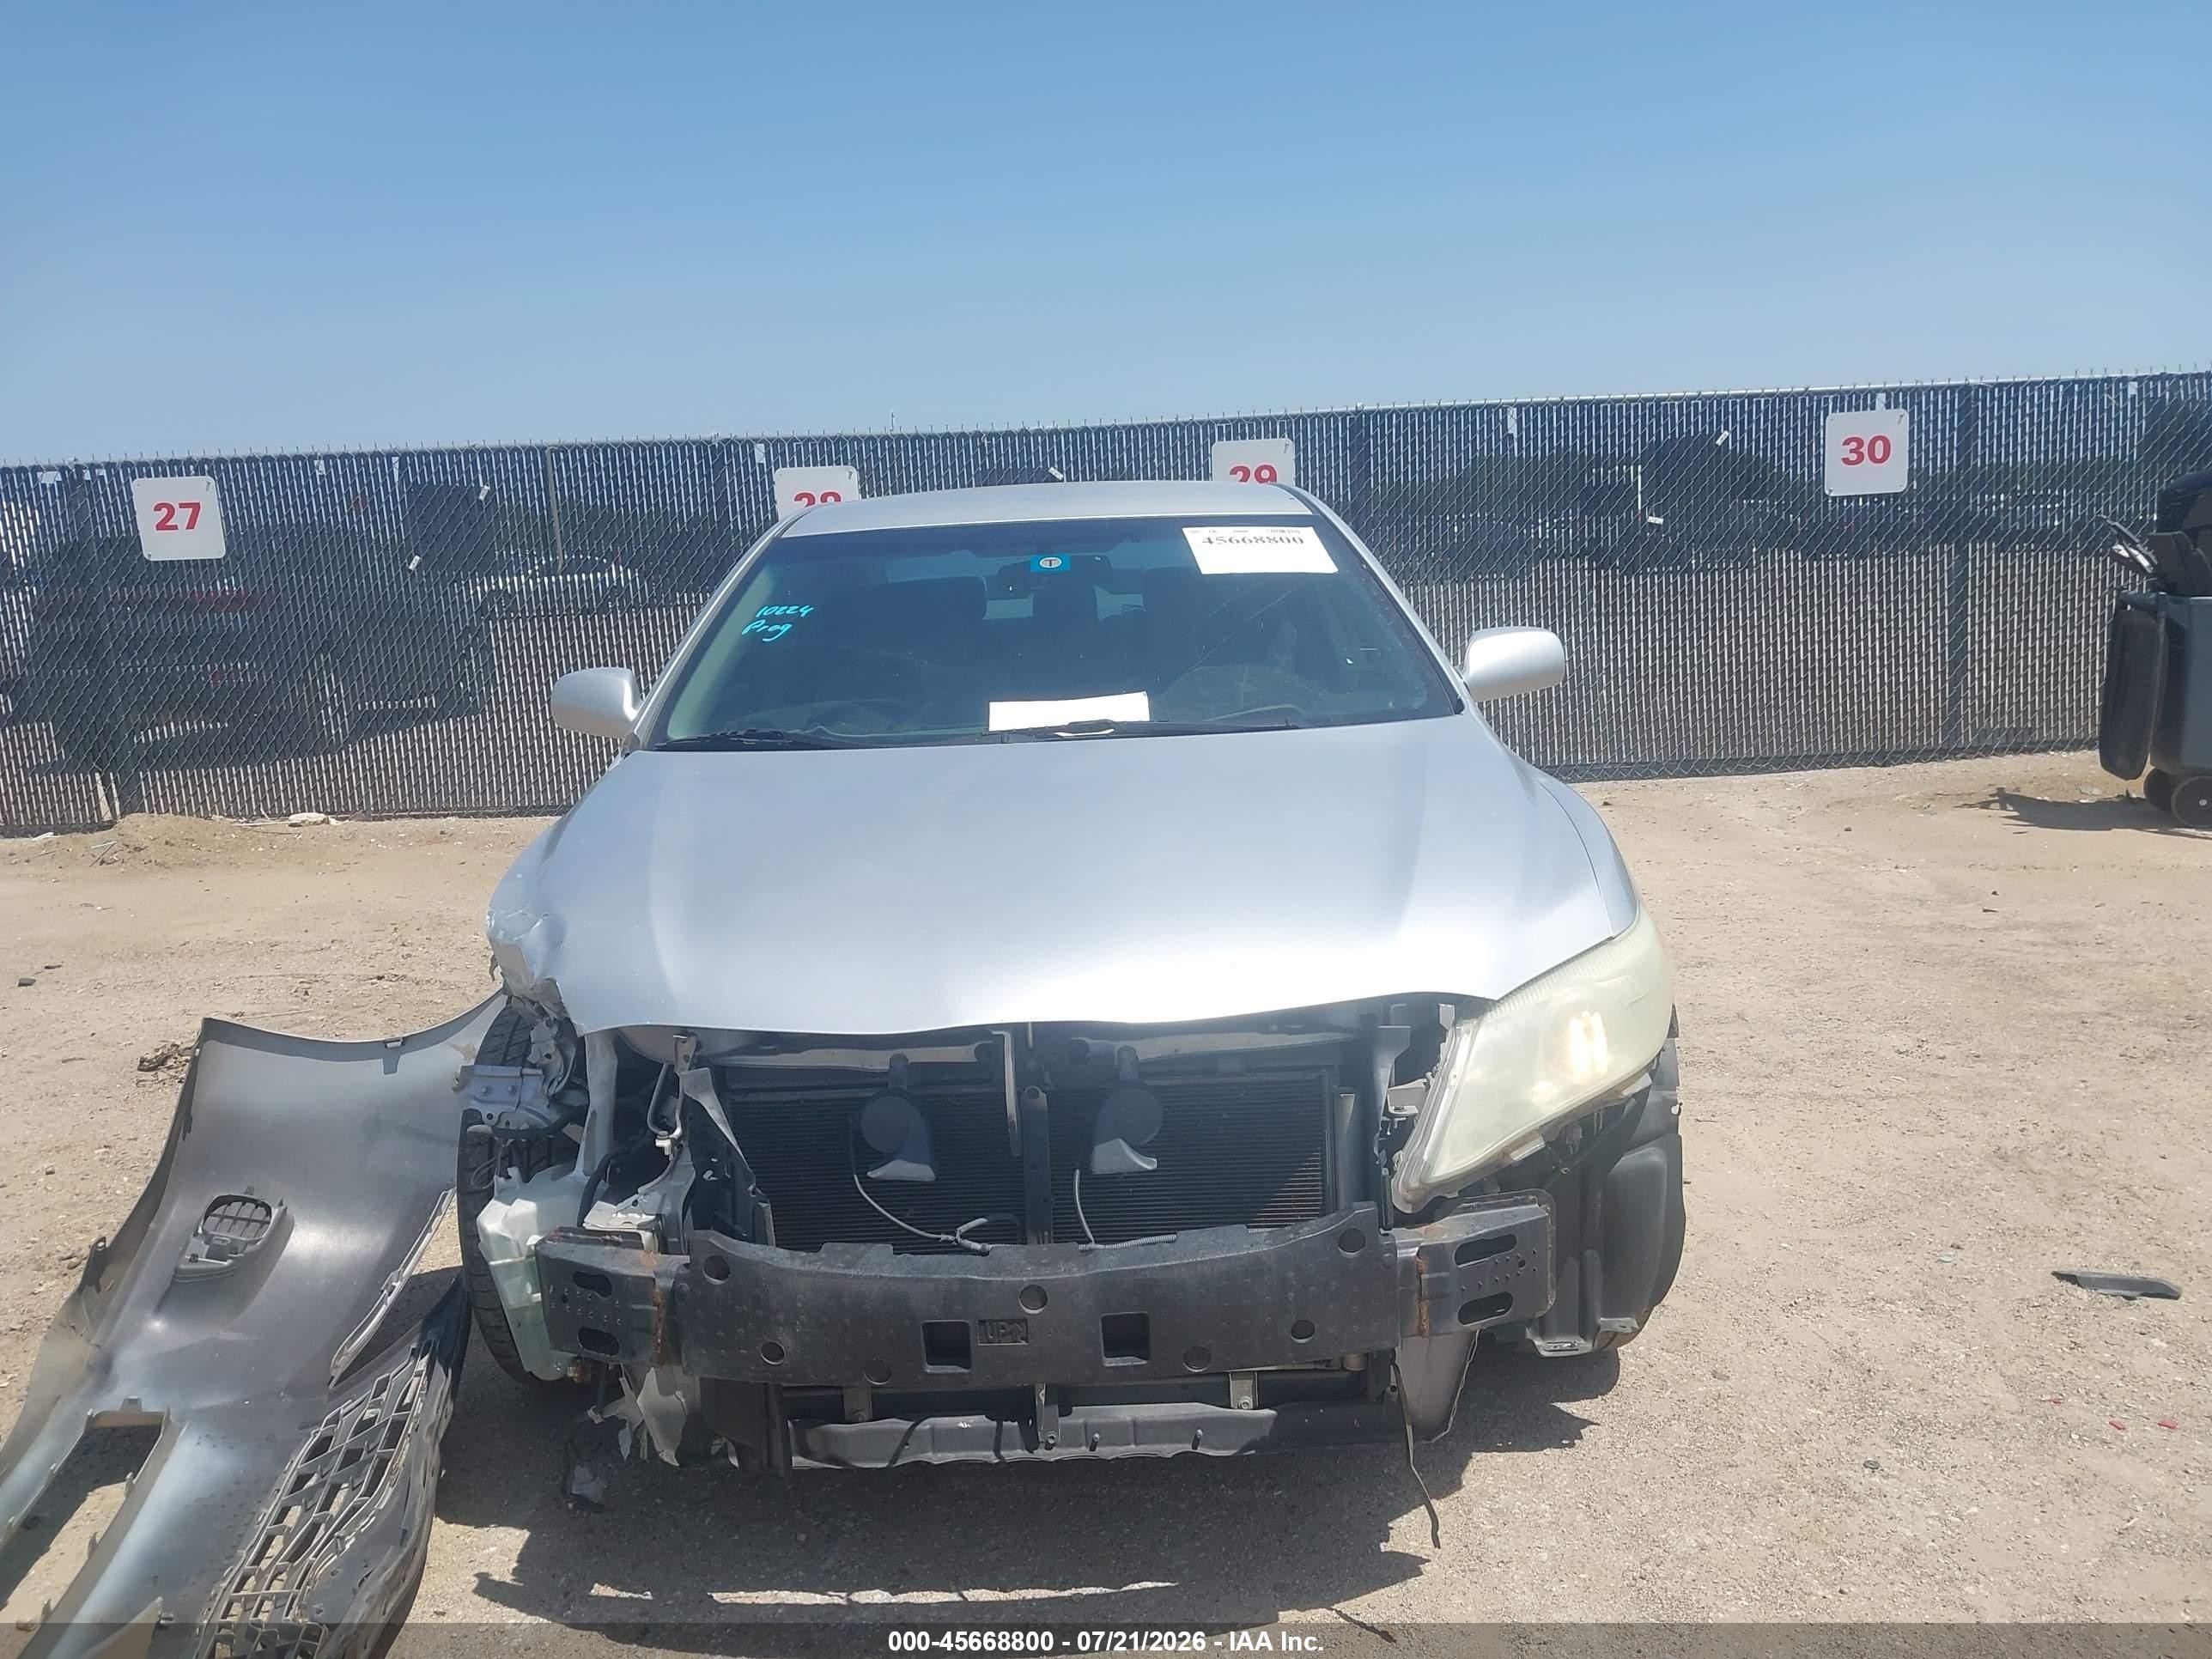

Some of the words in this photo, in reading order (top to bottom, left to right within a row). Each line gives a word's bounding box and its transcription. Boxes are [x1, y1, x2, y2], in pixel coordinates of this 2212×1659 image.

[1841, 434, 1892, 466] 30
[1229, 464, 1278, 484] 29
[153, 501, 201, 532] 27
[1202, 535, 1304, 546] 45668800
